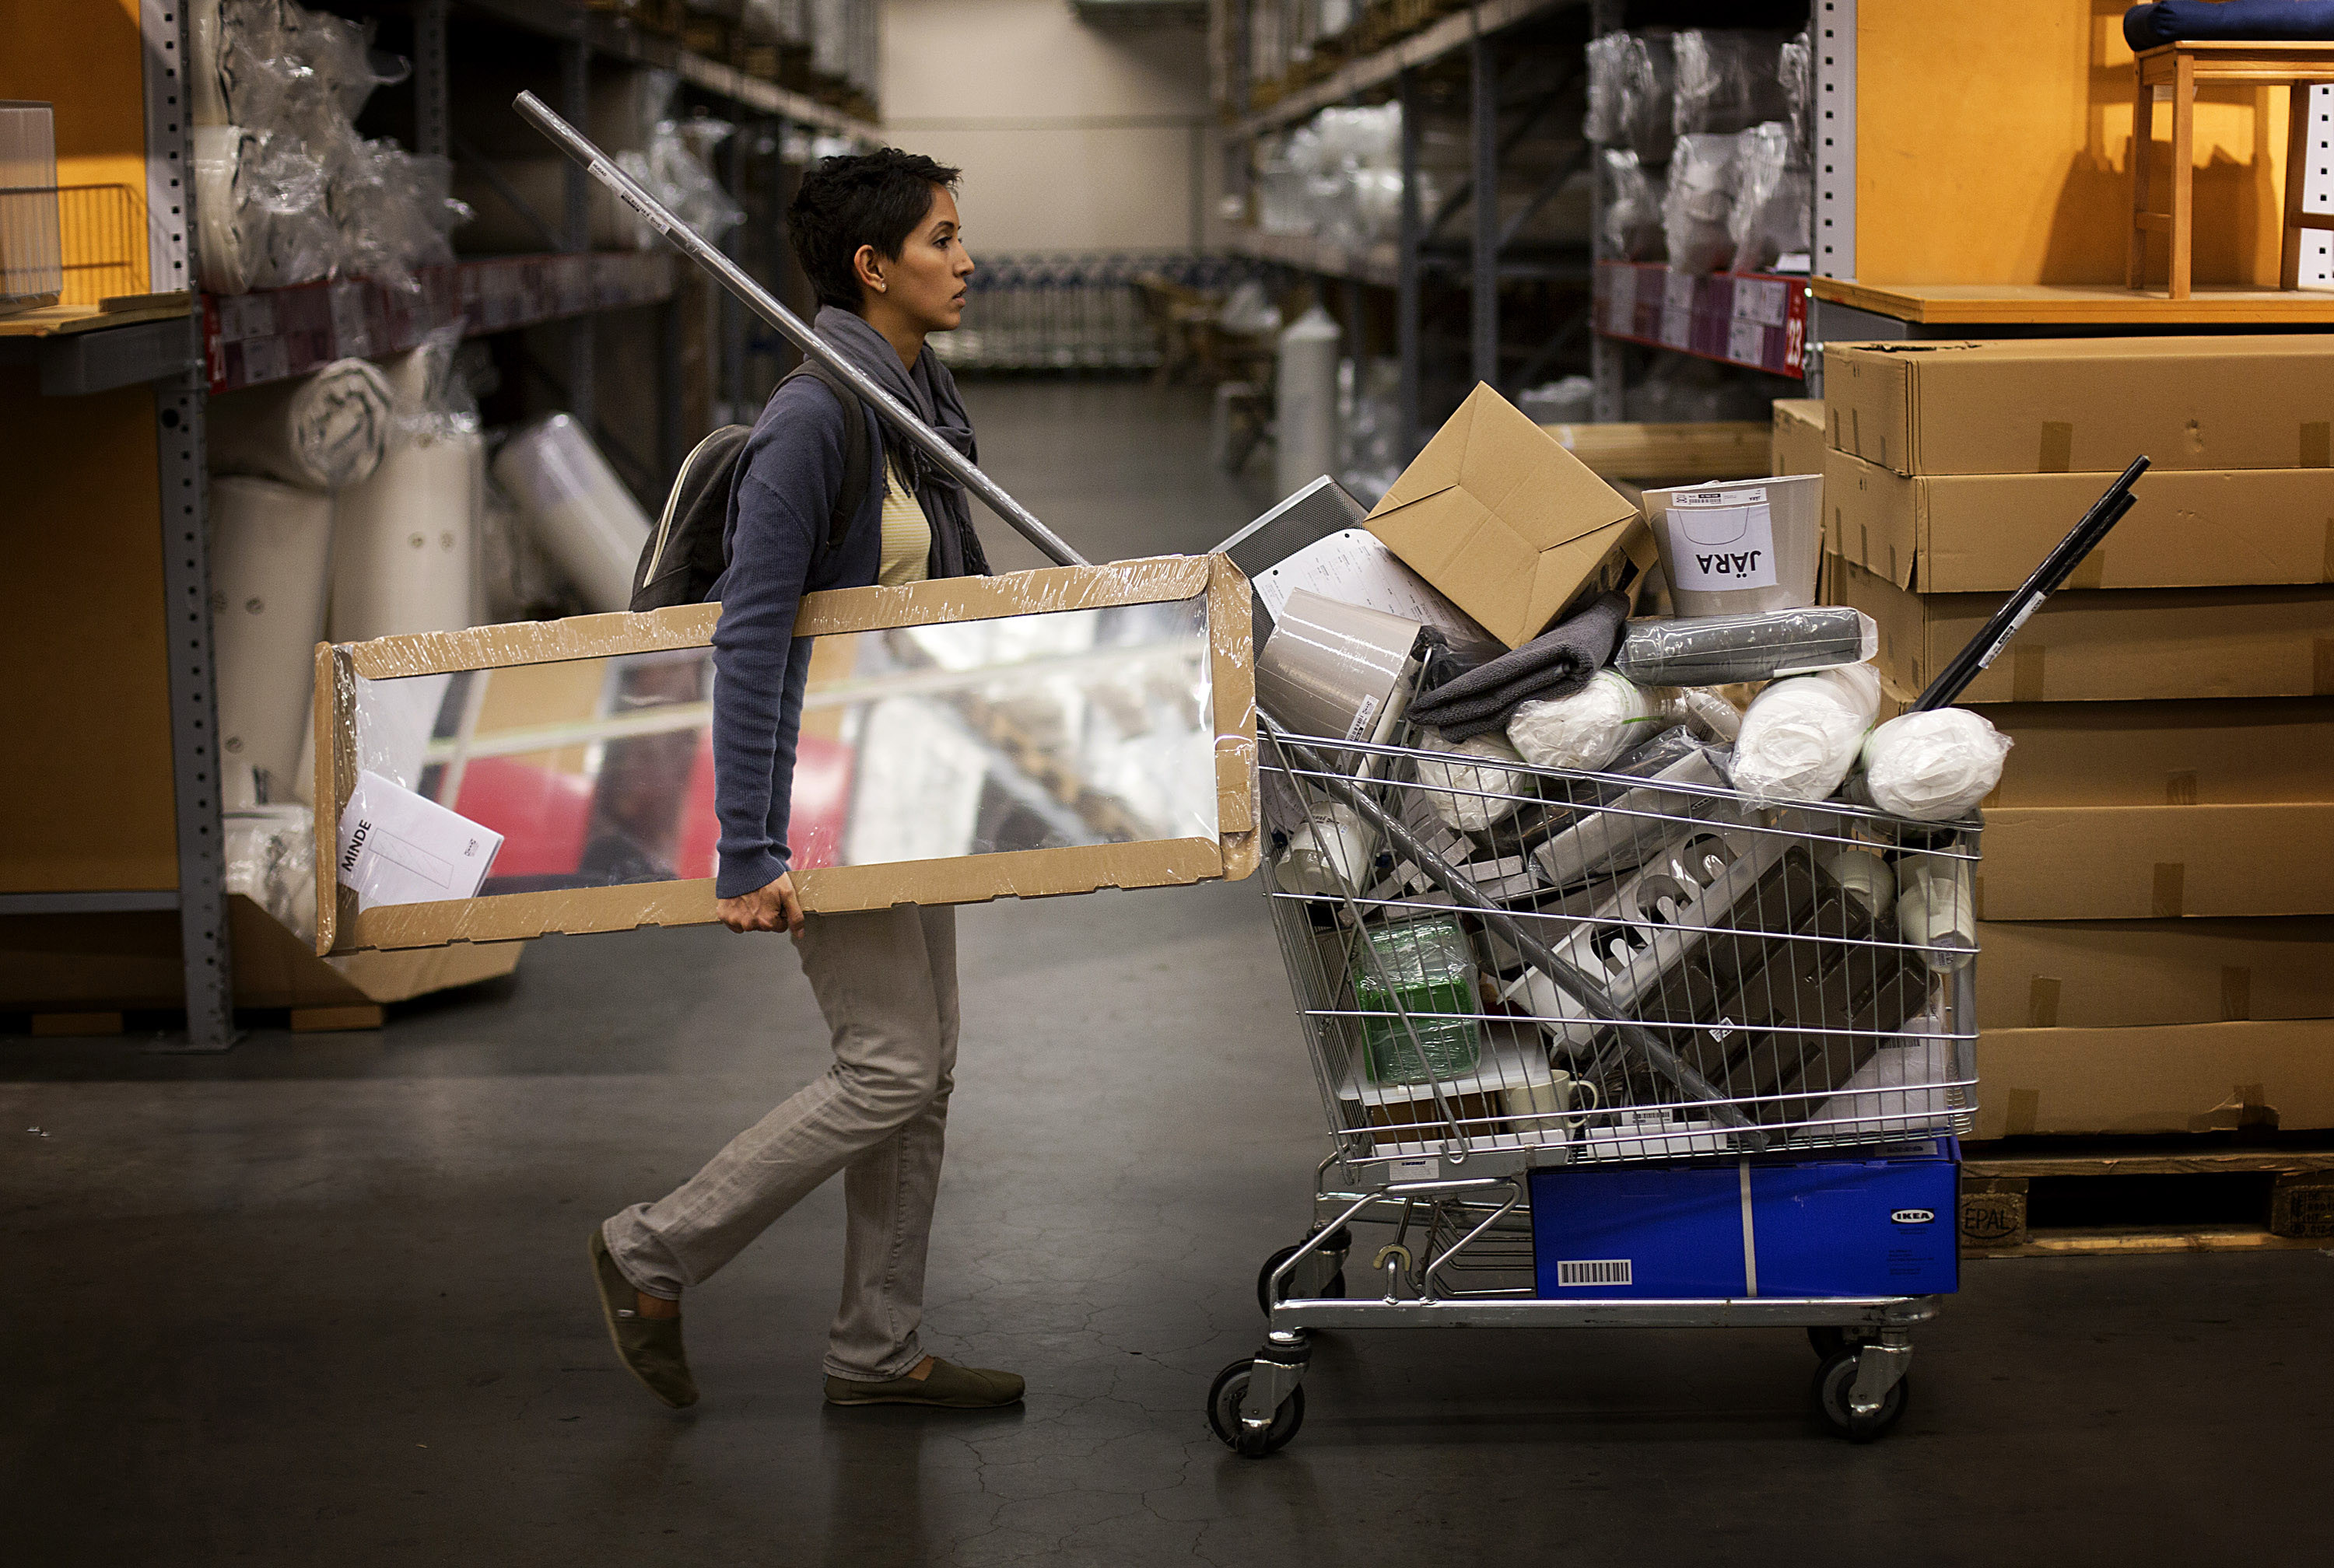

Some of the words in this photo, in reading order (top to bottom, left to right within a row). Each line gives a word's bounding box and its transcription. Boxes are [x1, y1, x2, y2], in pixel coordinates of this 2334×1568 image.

[1786, 318, 1803, 367] 23
[1696, 551, 1761, 578] JÄRA
[341, 819, 371, 872] MINDE
[1964, 1208, 2010, 1230] EPAL
